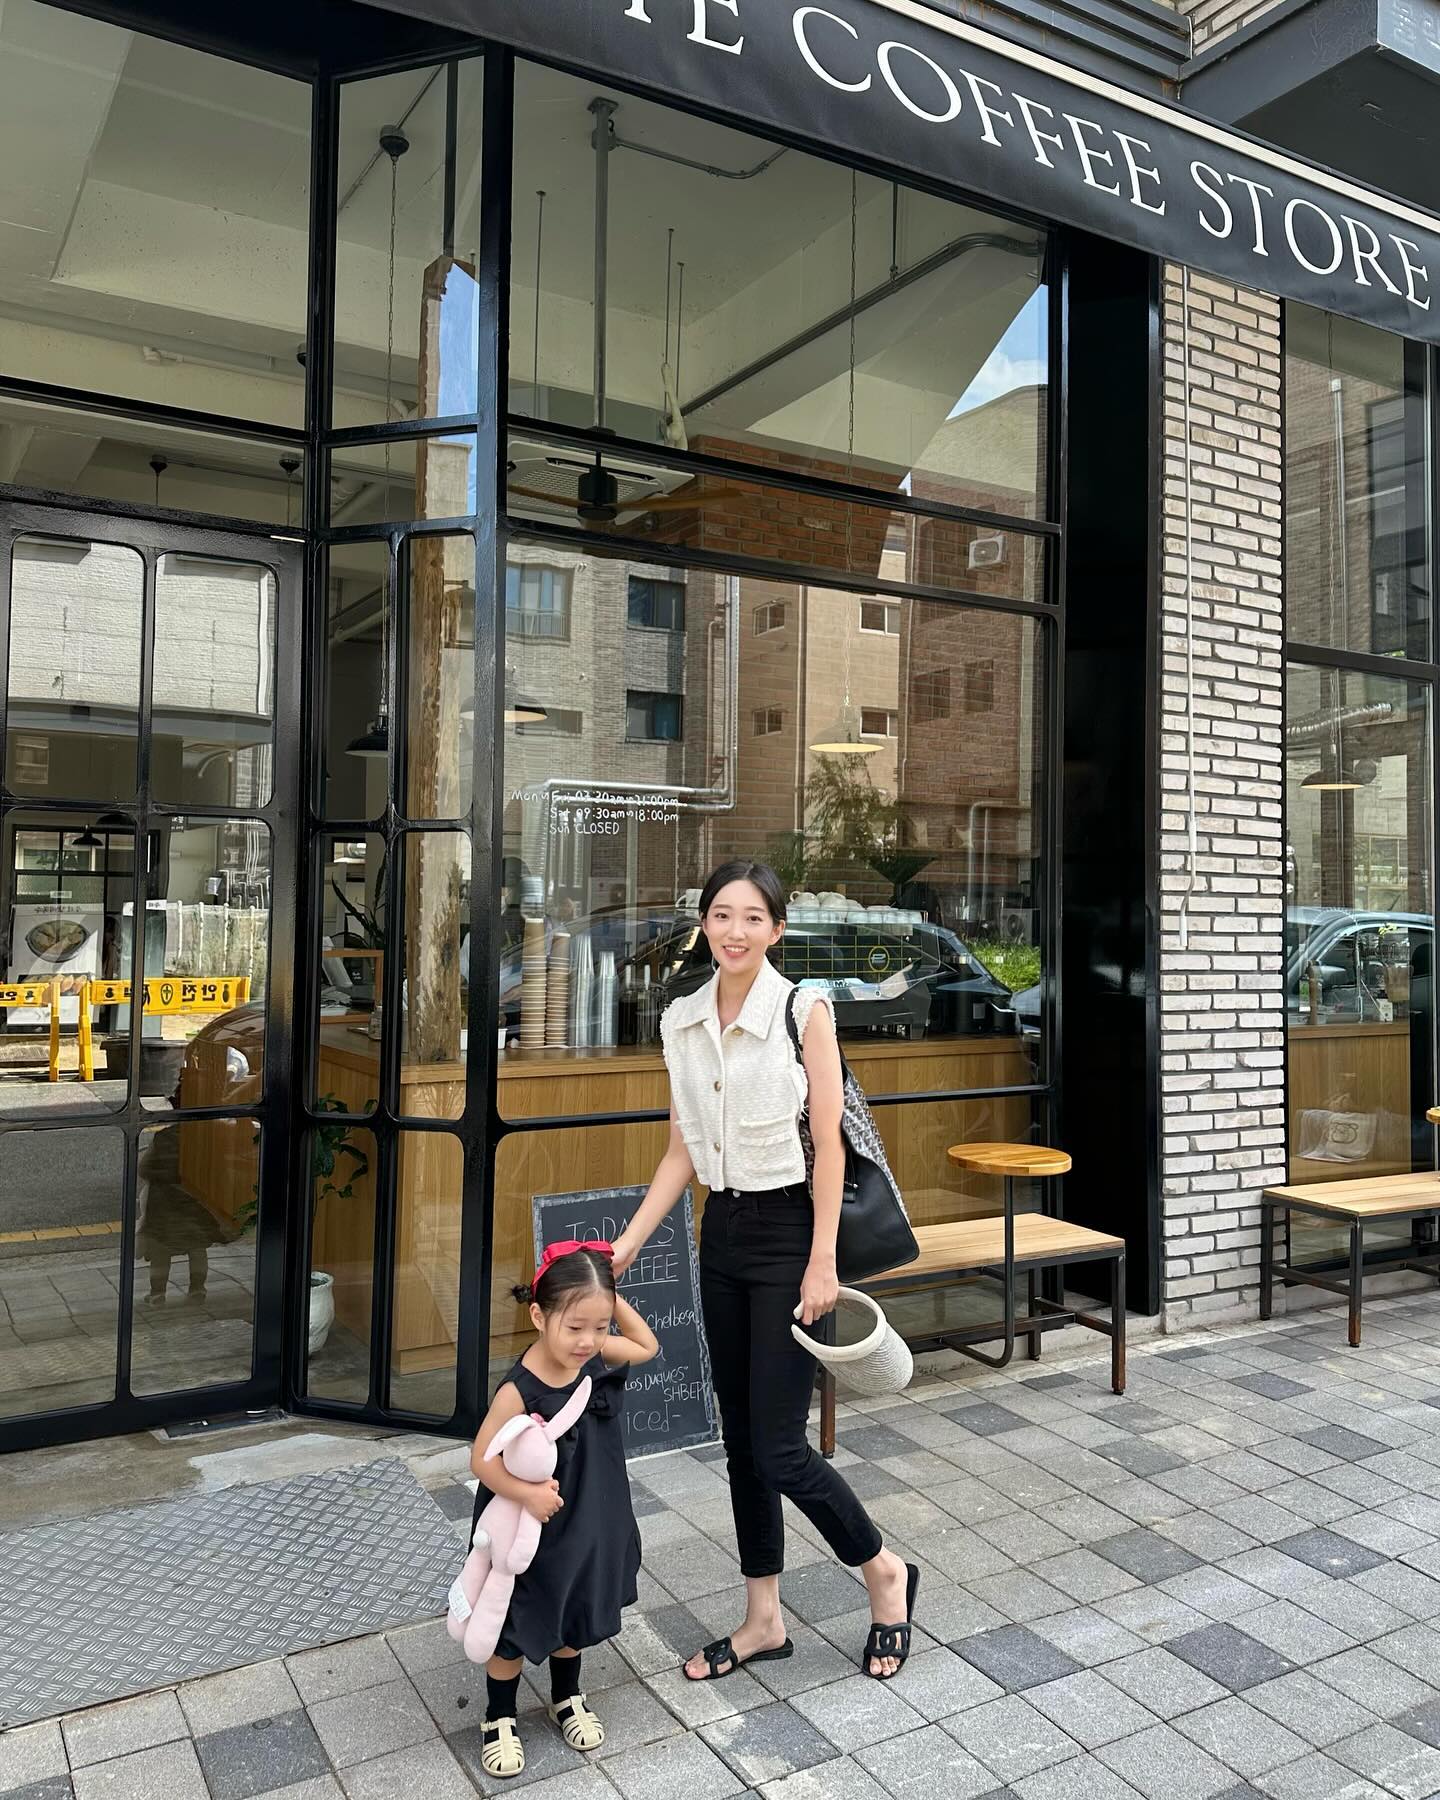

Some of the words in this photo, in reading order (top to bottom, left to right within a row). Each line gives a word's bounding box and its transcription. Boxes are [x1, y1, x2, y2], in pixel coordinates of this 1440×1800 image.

[792, 7, 1166, 217] COFFEE
[1189, 160, 1431, 312] STORE
[550, 807, 571, 820] Sat
[549, 822, 570, 835] Sun
[575, 822, 620, 835] CLOSED
